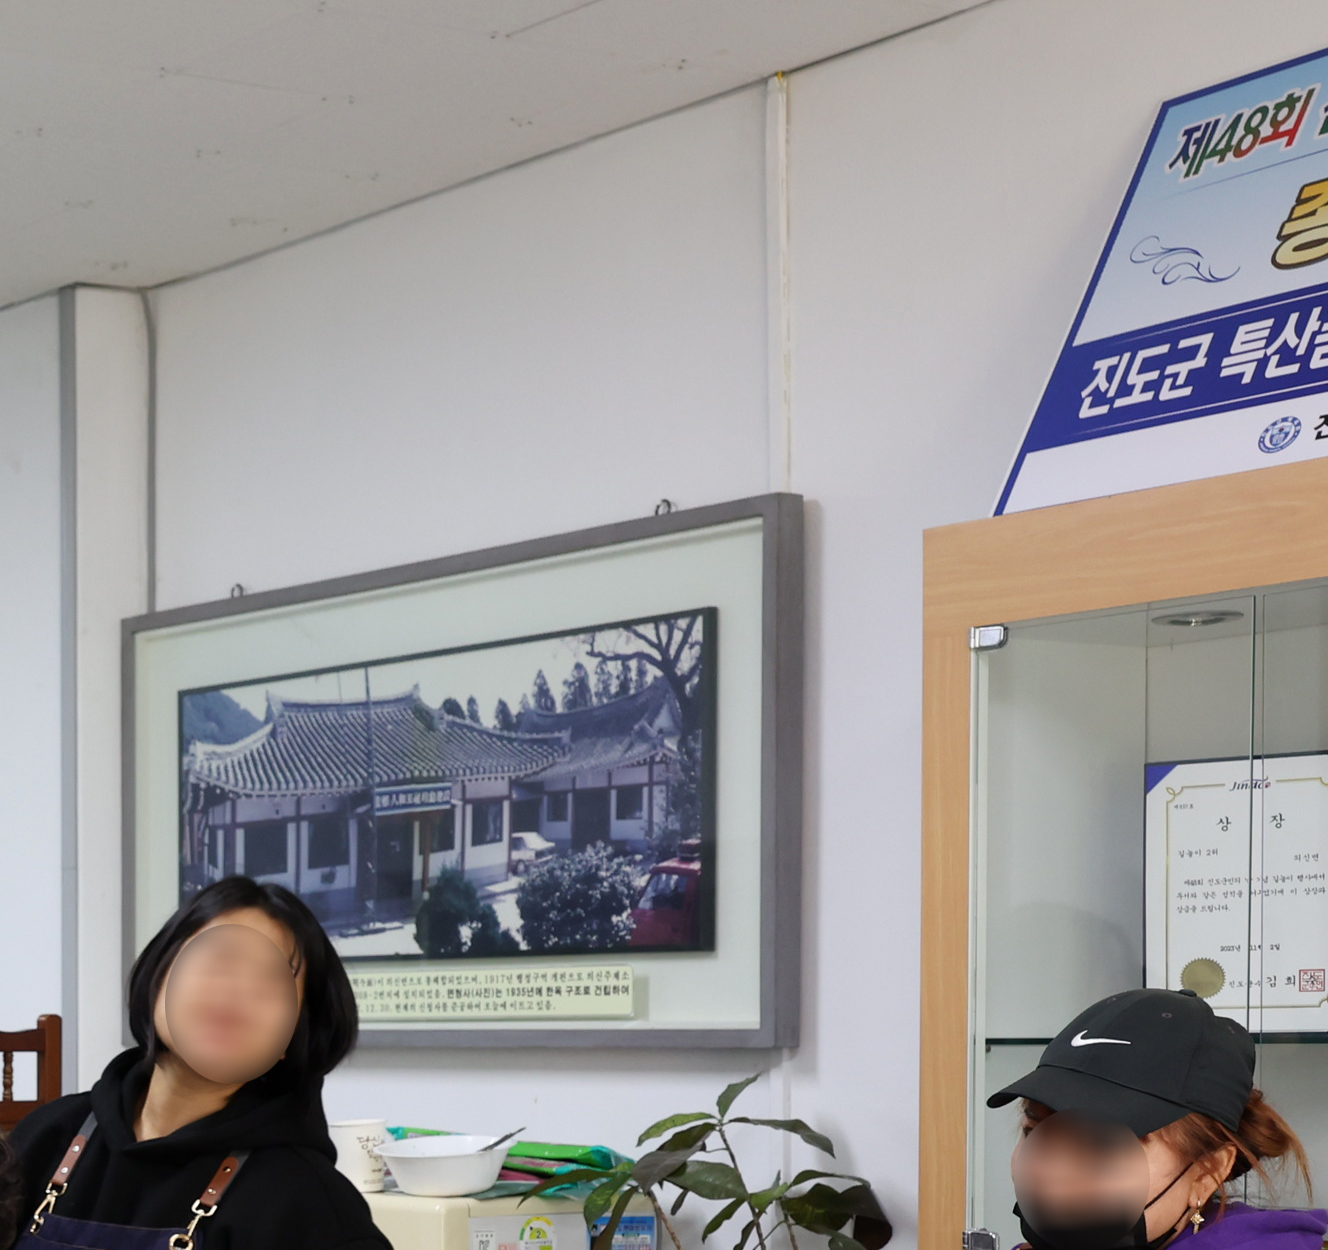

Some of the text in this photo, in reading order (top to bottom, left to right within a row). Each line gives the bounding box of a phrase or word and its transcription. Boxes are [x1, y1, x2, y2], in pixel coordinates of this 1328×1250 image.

[1166, 86, 1316, 180] 제48회
[1078, 331, 1215, 420] 진도군
[1216, 813, 1286, 832] 상 장
